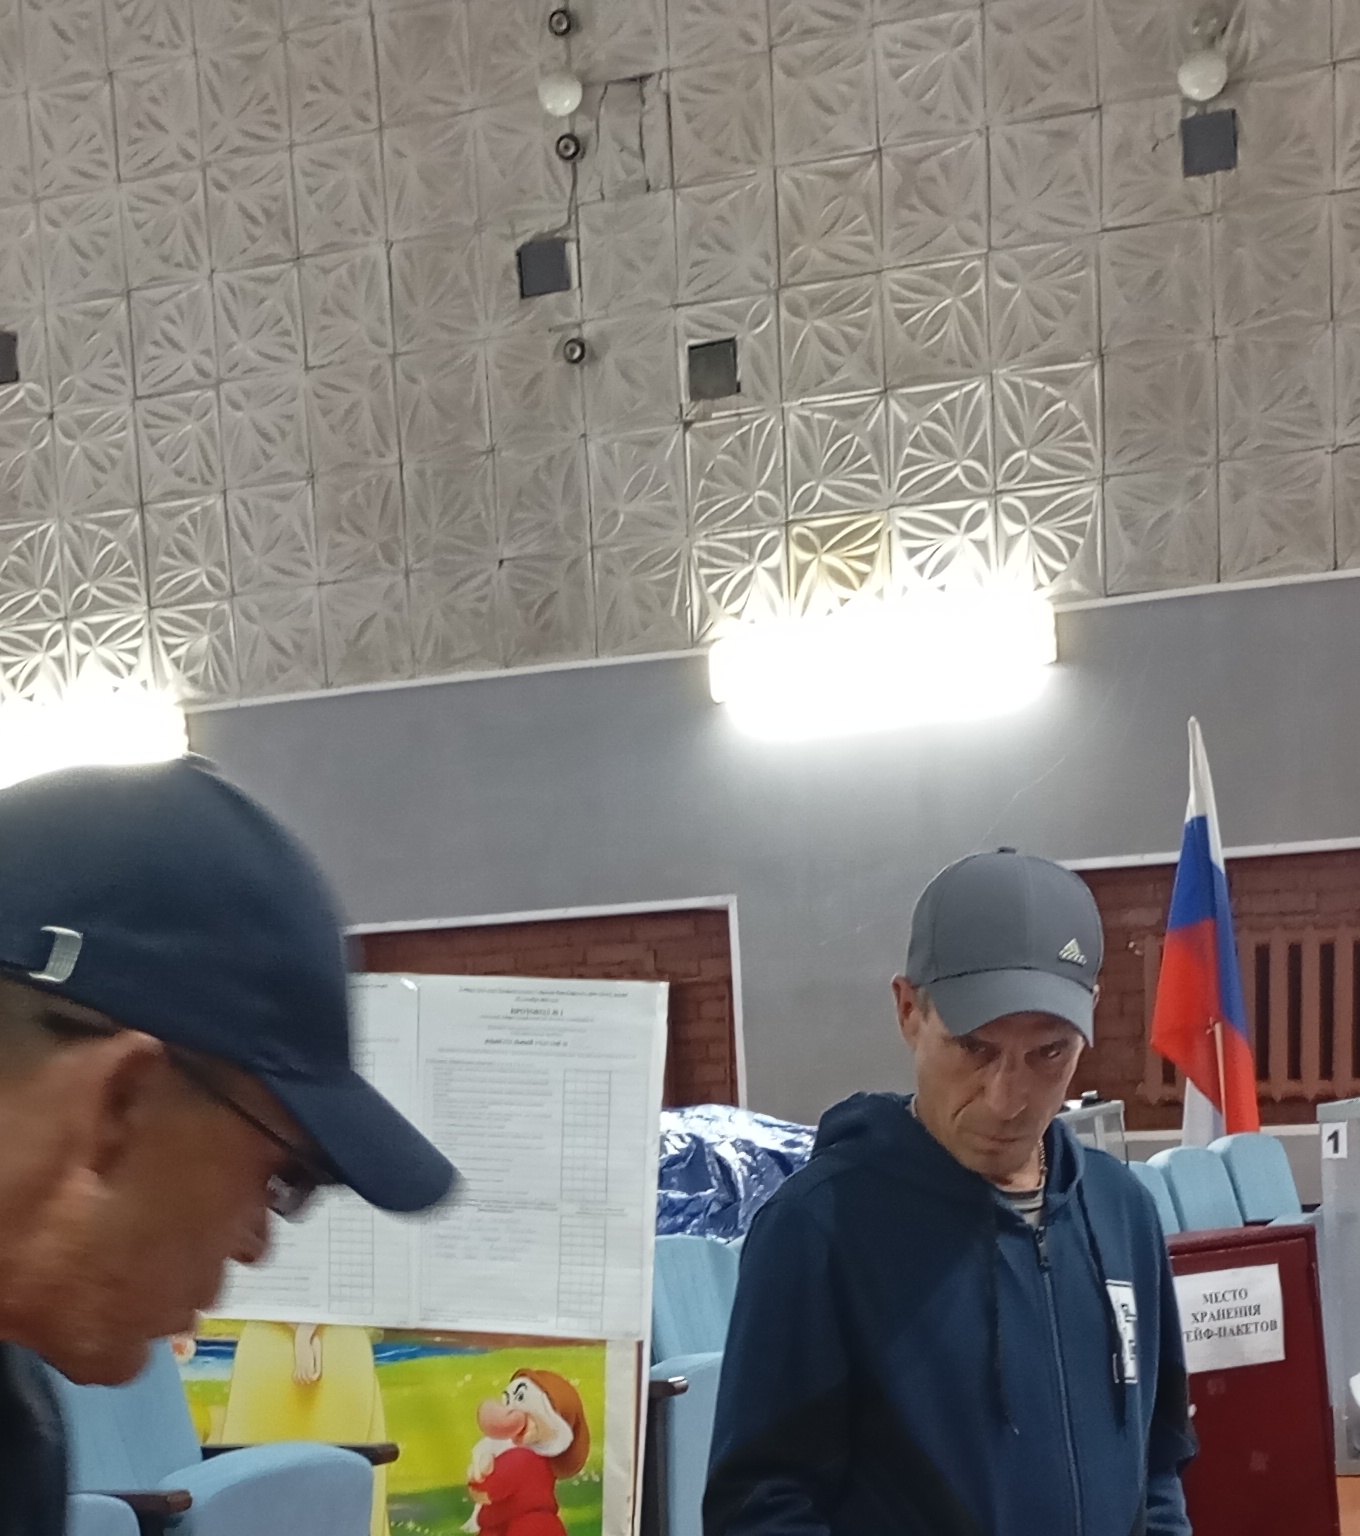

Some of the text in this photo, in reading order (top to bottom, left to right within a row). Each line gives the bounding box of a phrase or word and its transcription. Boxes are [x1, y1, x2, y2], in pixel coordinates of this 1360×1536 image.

[1327, 1130, 1339, 1154] 1
[1202, 1288, 1248, 1304] МЕСТО
[1191, 1304, 1261, 1324] ХРАНЕНИЯ
[1184, 1319, 1278, 1343] ЕЙФ-ПАКЕТОВ
